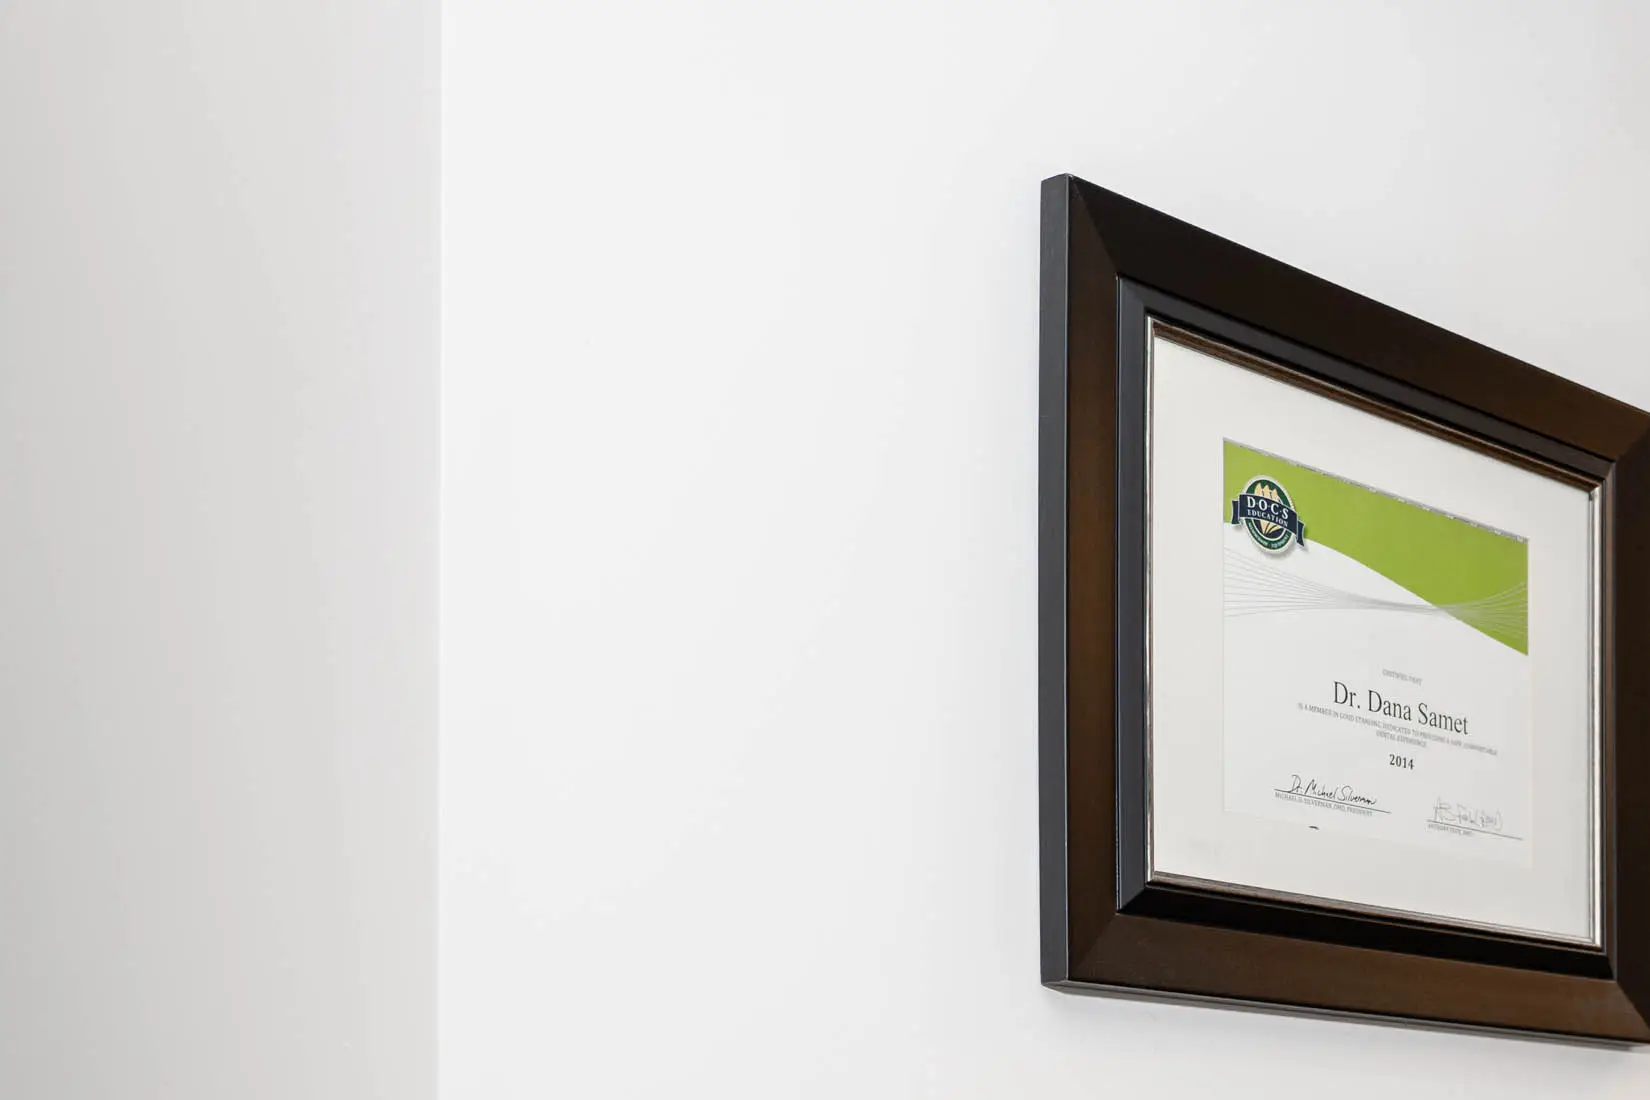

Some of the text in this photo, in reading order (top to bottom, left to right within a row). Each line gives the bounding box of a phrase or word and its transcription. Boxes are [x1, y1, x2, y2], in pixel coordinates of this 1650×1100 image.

[1247, 509, 1288, 527] EDUCATION
[1333, 680, 1469, 735] Dr. Dana Samet
[1389, 753, 1415, 770] 2014
